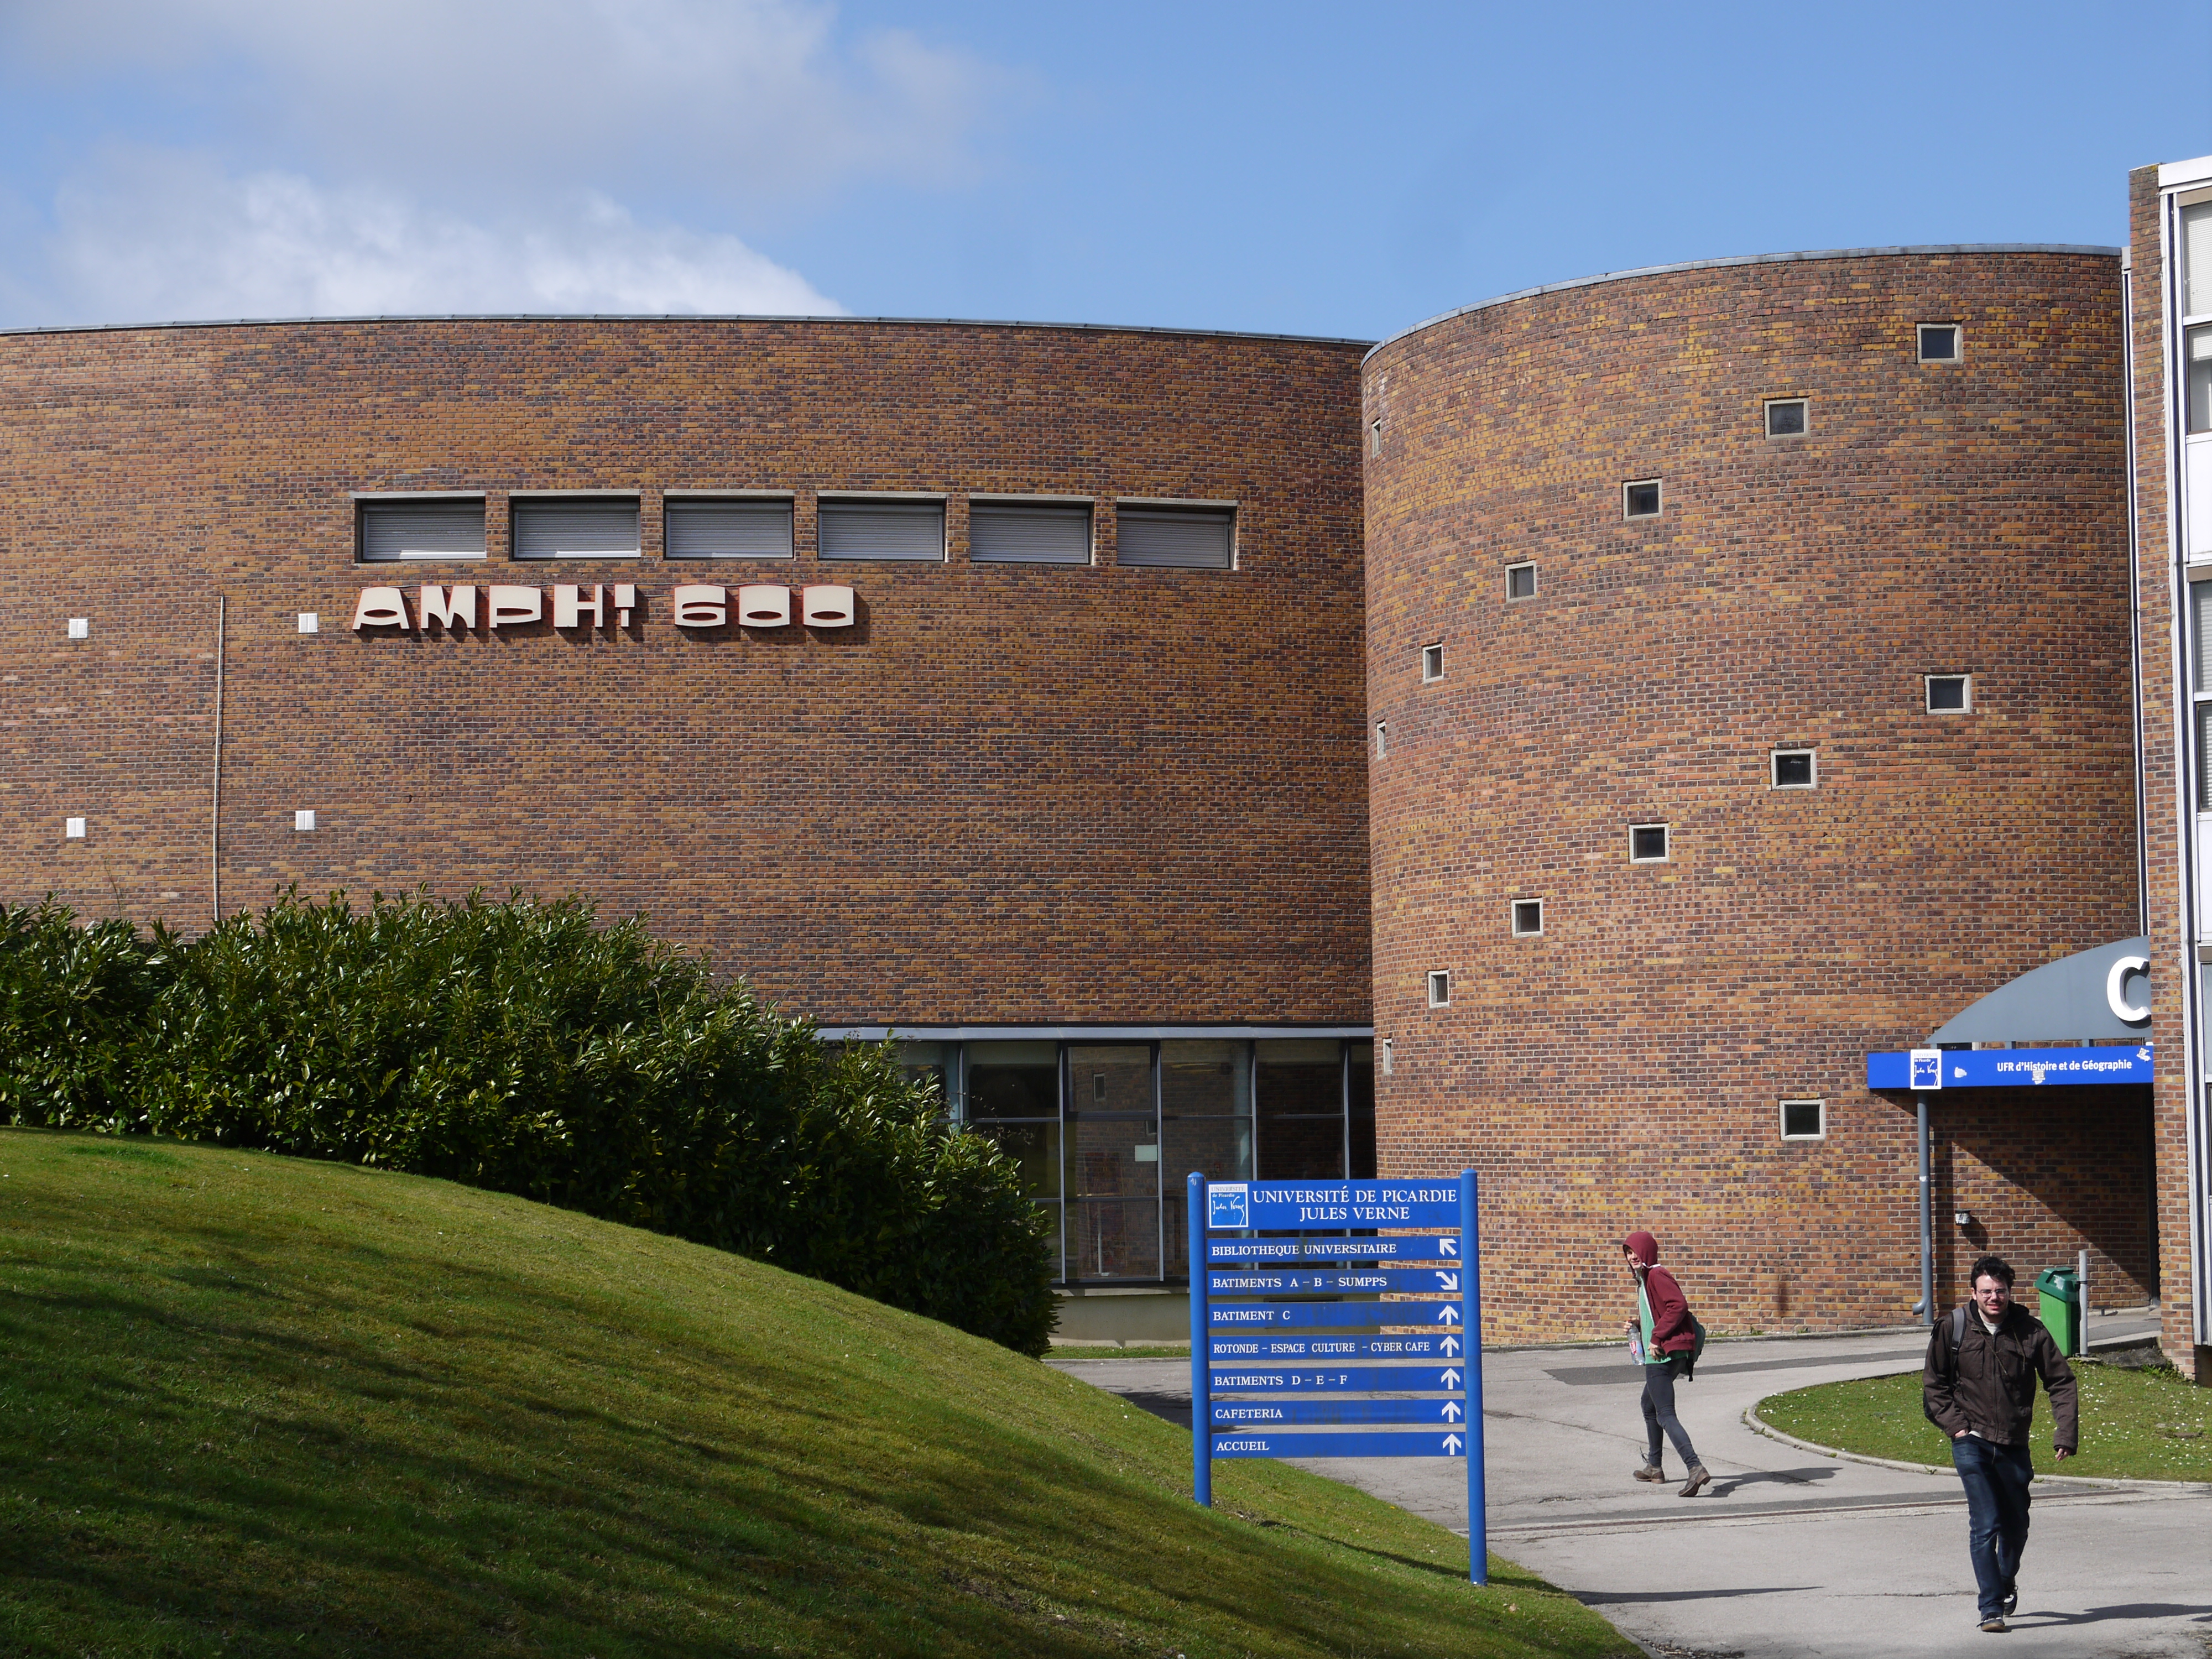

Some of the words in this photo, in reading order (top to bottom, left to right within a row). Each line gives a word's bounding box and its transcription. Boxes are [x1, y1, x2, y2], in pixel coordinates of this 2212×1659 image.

[674, 584, 855, 628] 600
[2106, 956, 2151, 1021] C
[1997, 1062, 2014, 1072] UFR
[2059, 1062, 2068, 1071] et
[2069, 1060, 2080, 1071] de
[2081, 1059, 2133, 1072] Géographie
[1253, 1185, 1350, 1203] UNIVERSITÉ
[1355, 1190, 1376, 1203] DE
[1382, 1190, 1457, 1202] PICARDIE
[1300, 1207, 1347, 1222] JULES
[1354, 1207, 1410, 1219] VERNE
[1212, 1245, 1300, 1256] BIBLIOTHEQUE
[1303, 1244, 1397, 1255] UNIVERSITAIRE
[1213, 1278, 1282, 1288] BATIMENTS
[1290, 1278, 1299, 1287] A
[1314, 1277, 1322, 1287] B
[1338, 1277, 1387, 1287] SUMPPS
[1213, 1311, 1275, 1321] BATIMENT
[1282, 1310, 1290, 1320] C
[1213, 1344, 1259, 1353] ROTONDE
[1270, 1343, 1306, 1353] ESPACE
[1311, 1343, 1355, 1353] CULTURE
[1370, 1342, 1402, 1352] CYBER
[1405, 1342, 1430, 1352] CAFE
[1214, 1375, 1284, 1386] BATIMENTS
[1291, 1375, 1301, 1385] D
[1316, 1375, 1324, 1385] E
[1339, 1375, 1348, 1385] F
[1215, 1408, 1283, 1418] CAFETERIA
[1216, 1441, 1270, 1451] ACCUEIL
